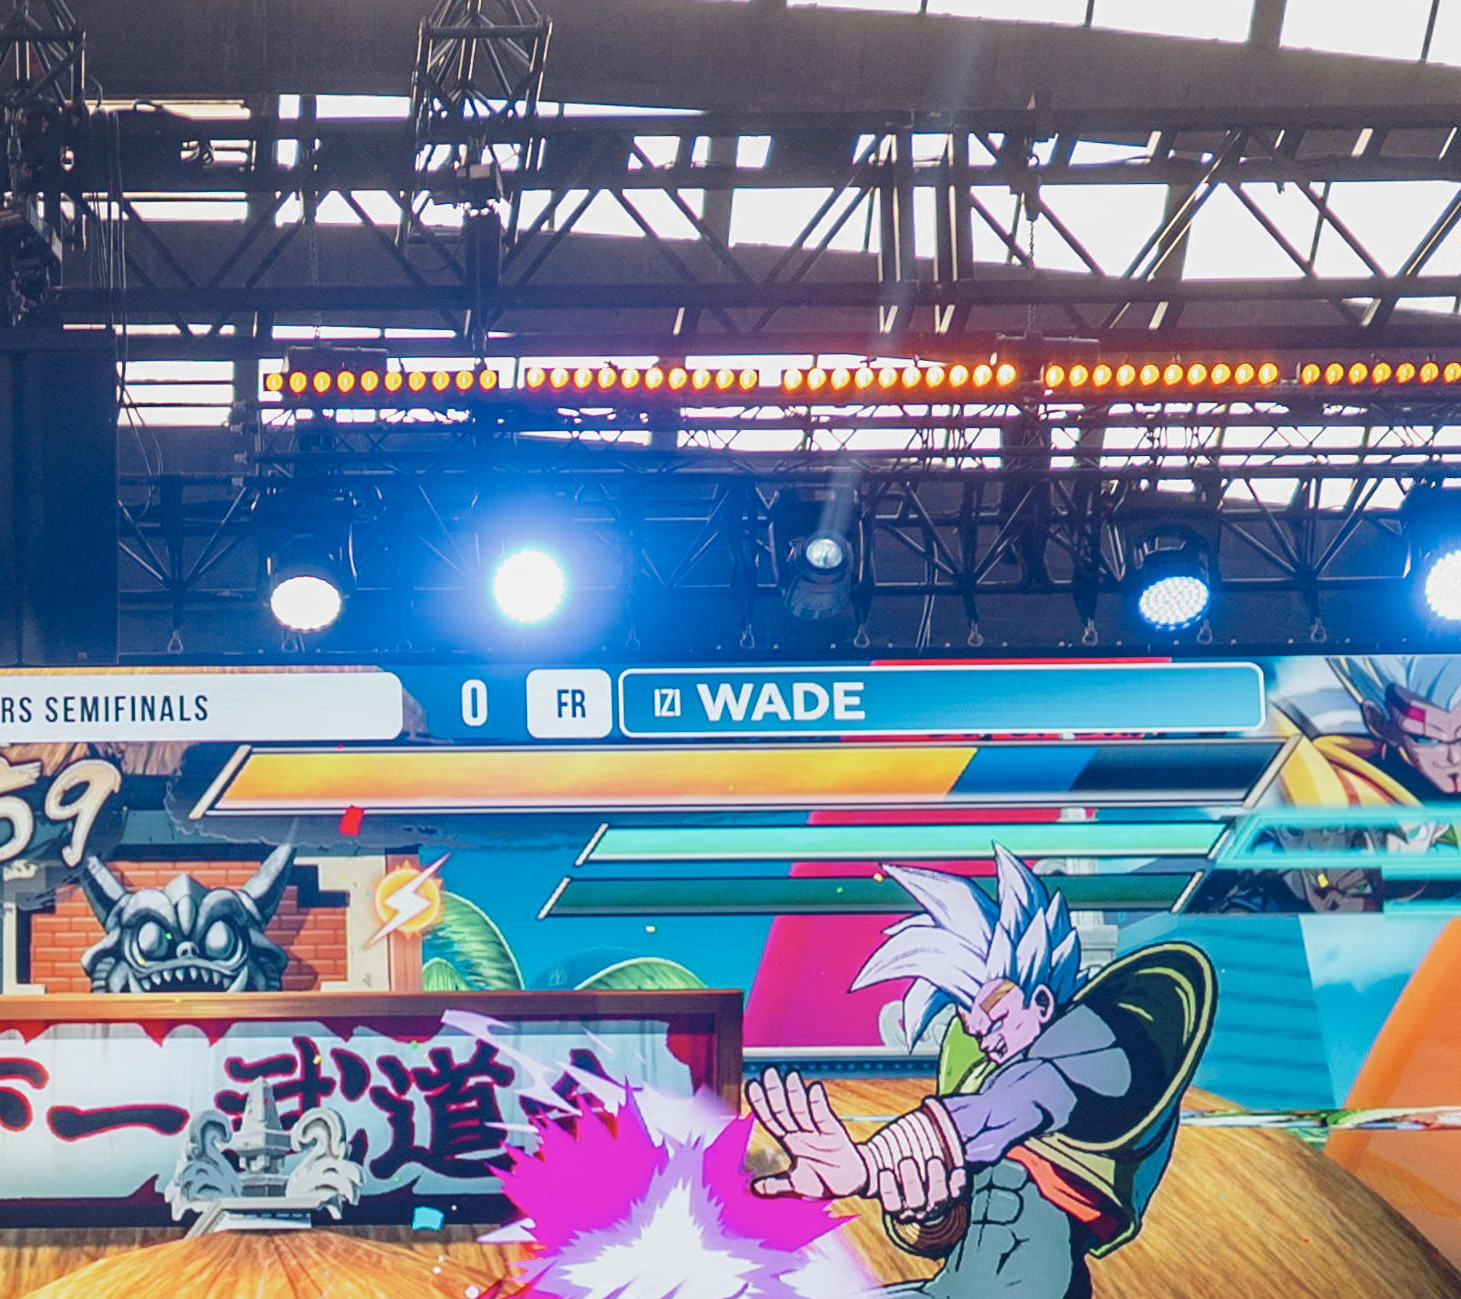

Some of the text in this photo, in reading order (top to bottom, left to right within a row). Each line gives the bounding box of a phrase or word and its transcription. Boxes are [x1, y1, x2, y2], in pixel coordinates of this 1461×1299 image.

[45, 694, 209, 722] SEMIFINALS
[461, 679, 488, 727] 0
[556, 688, 587, 718] FR
[696, 681, 866, 721] WADE
